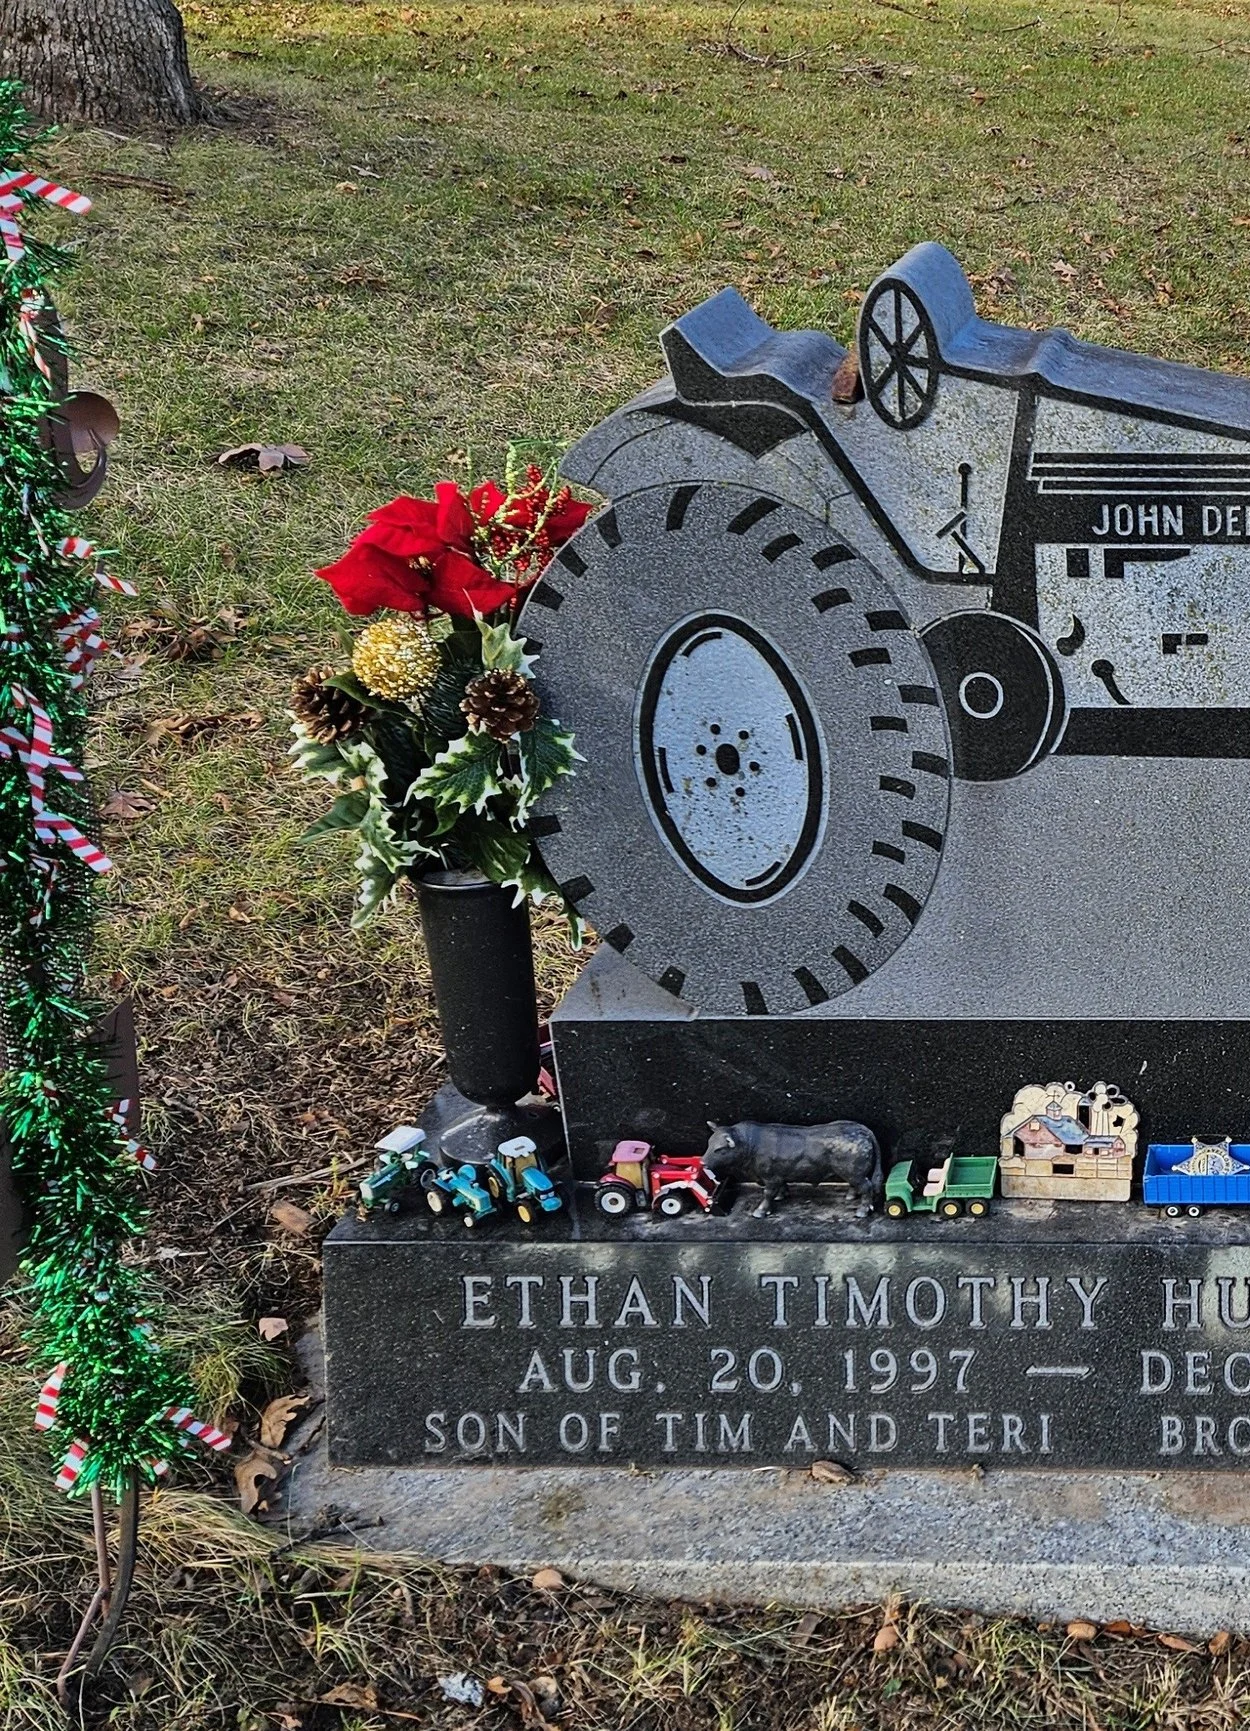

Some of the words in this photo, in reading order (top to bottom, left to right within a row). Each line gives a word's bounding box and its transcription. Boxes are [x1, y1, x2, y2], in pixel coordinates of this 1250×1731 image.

[1092, 503, 1184, 537] JOHN
[461, 1275, 712, 1330] ETHAN
[760, 1274, 1108, 1331] TIMOTHY
[518, 1347, 667, 1394] AUG.
[710, 1346, 802, 1397] 20,
[844, 1346, 976, 1395] 1997
[424, 1411, 527, 1453] SON
[559, 1411, 621, 1453] OF
[656, 1411, 754, 1453] TIM
[784, 1411, 898, 1453] AND
[928, 1411, 1053, 1454] TERI
